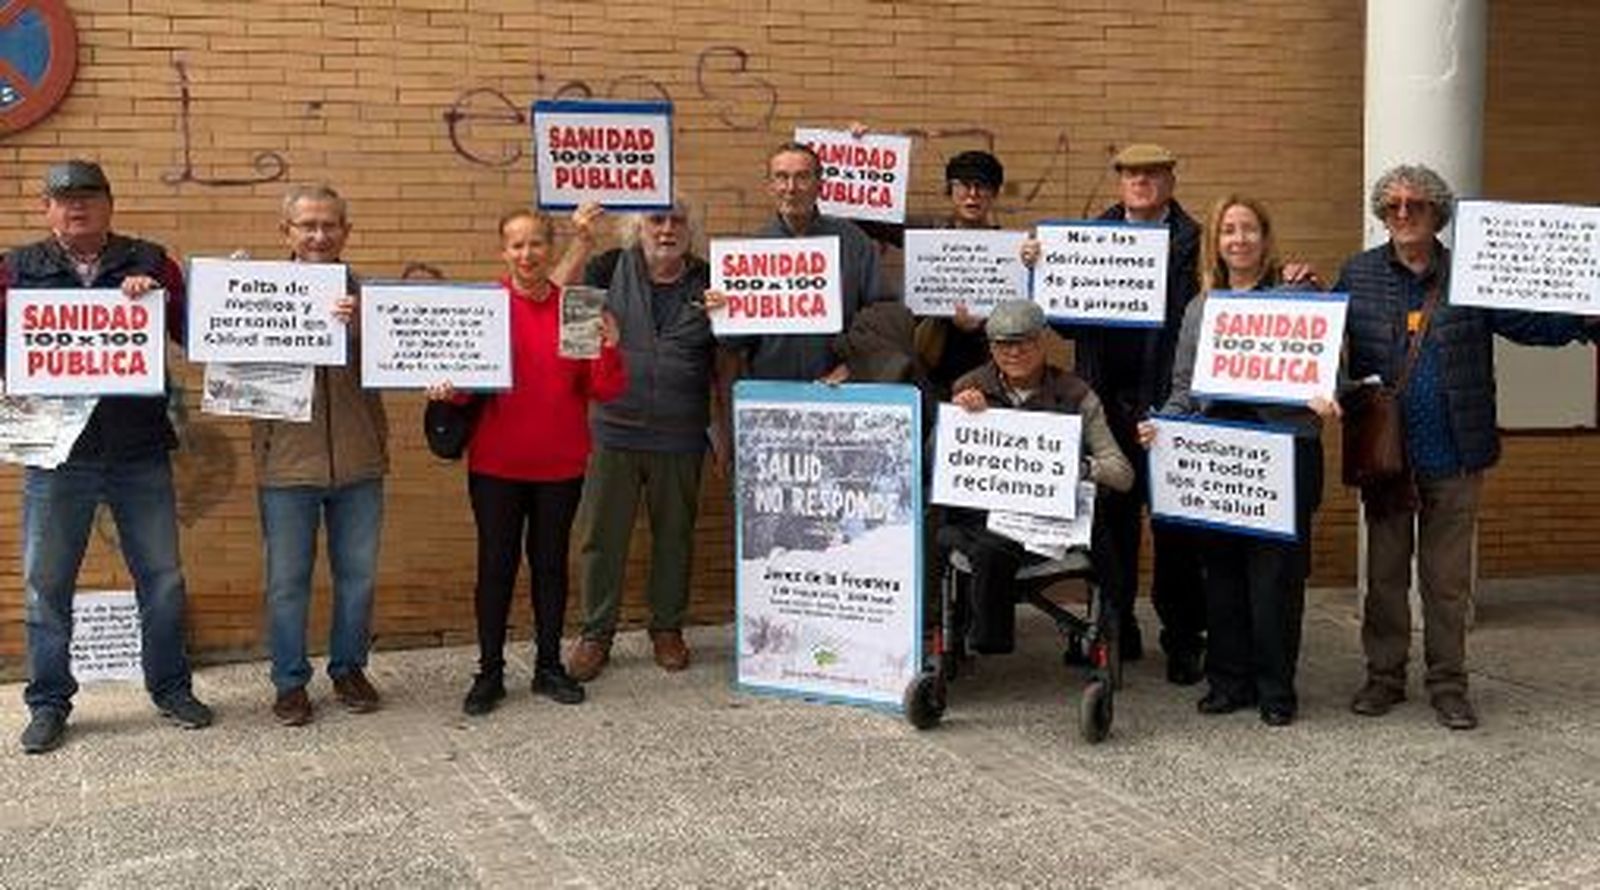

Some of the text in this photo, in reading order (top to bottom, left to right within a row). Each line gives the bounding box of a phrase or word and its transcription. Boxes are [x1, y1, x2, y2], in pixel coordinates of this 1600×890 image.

[549, 125, 655, 152] SANIDAD
[550, 151, 591, 165] 100
[614, 153, 655, 166] 100
[556, 163, 655, 191] PÚBLICA
[860, 170, 895, 183] 100
[1112, 232, 1137, 245] las
[722, 251, 826, 277] SANIDAD
[1046, 254, 1156, 268] derivaciones
[228, 279, 309, 295] Falta de
[723, 279, 764, 291] 100
[787, 276, 828, 290] 100
[1044, 275, 1156, 291] de pacientes
[302, 301, 312, 315] y
[727, 292, 827, 318] PÚBLICA
[1065, 296, 1079, 309] la
[1084, 297, 1149, 313] privada
[22, 304, 148, 331] SANIDAD
[209, 315, 297, 330] personal
[1214, 311, 1328, 340] SANIDAD
[24, 332, 148, 347] 100 x 100
[263, 333, 333, 347] mental
[1214, 337, 1254, 351] 100
[1281, 340, 1324, 355] 100
[27, 344, 148, 377] PÚBLICA
[1212, 353, 1319, 384] PÚBLICA
[955, 427, 1061, 452] Utiliza tu
[1173, 436, 1271, 462] Pediatras
[756, 453, 821, 482] SALUD
[949, 449, 1064, 476] derecho a
[1178, 459, 1266, 481] en todos
[953, 474, 1055, 498] reclamar
[1166, 471, 1278, 501] los centros
[755, 486, 900, 520] NO RESPONDE
[1180, 494, 1265, 517] de salud
